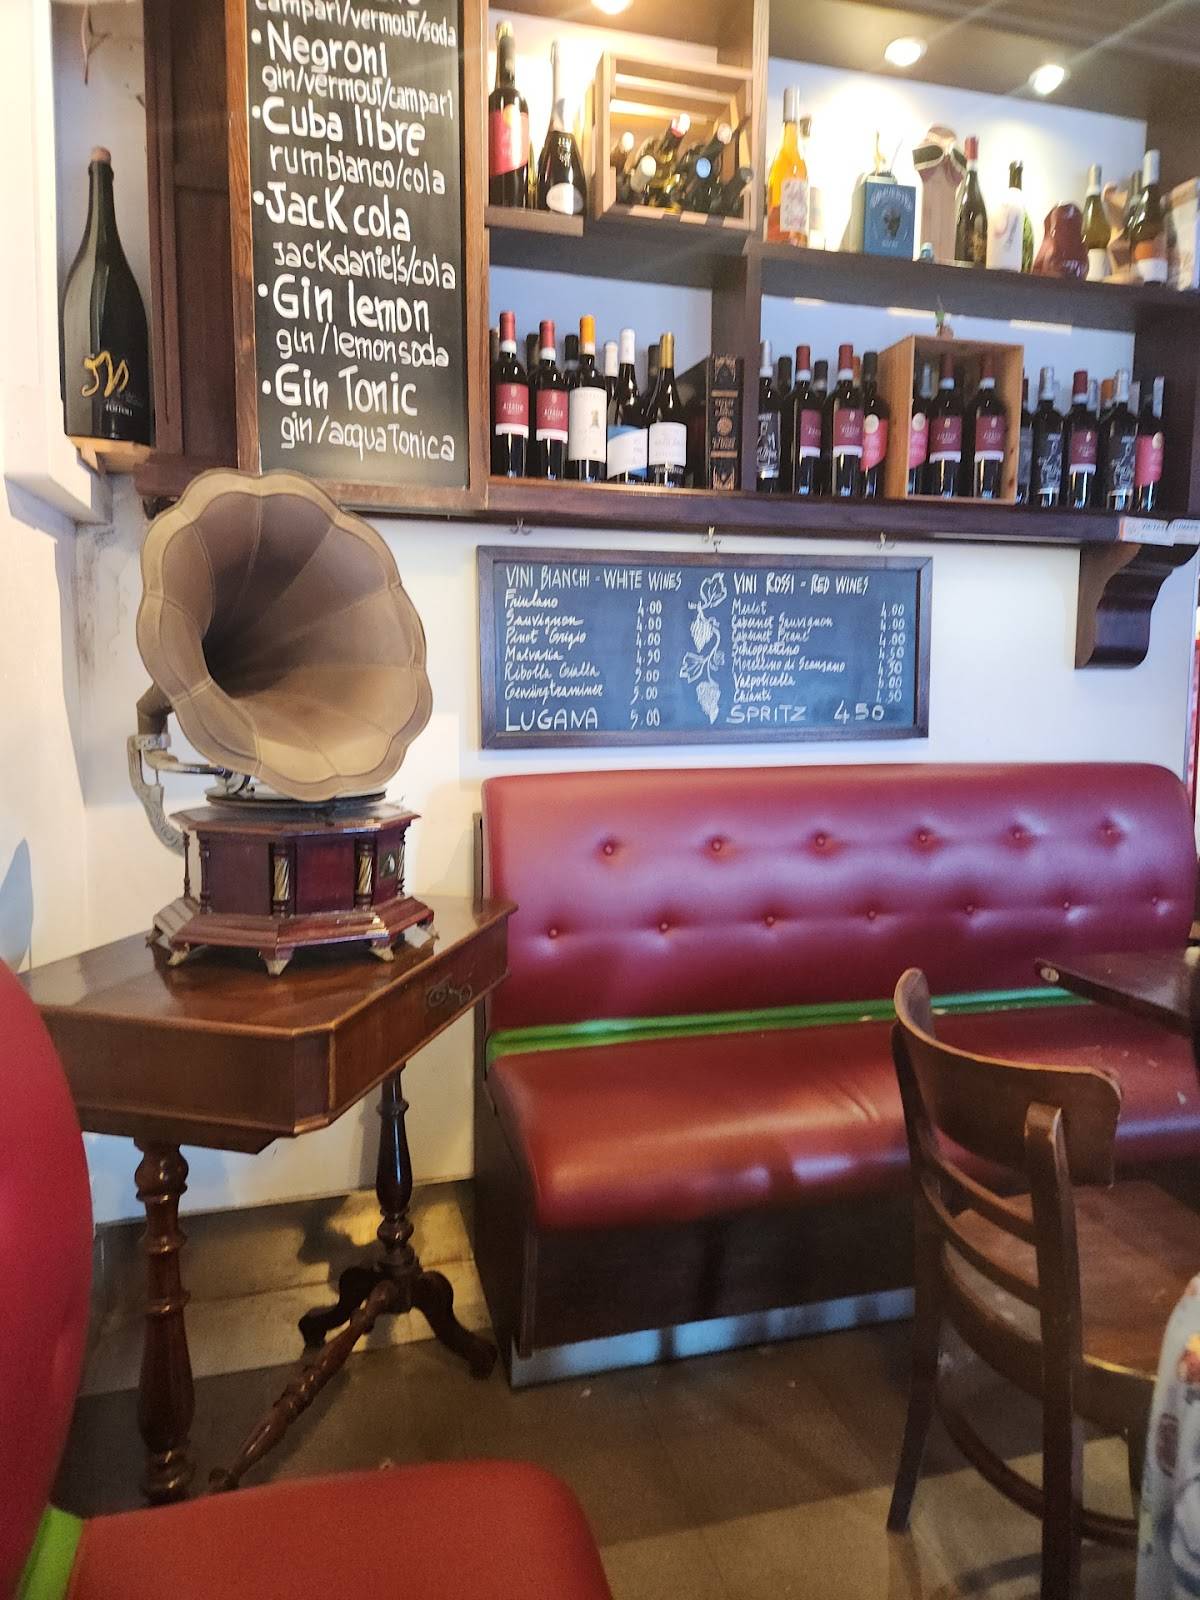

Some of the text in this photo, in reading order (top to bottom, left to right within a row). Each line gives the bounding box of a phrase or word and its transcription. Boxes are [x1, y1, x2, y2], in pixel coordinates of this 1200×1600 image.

[267, 20, 388, 78] Negroni
[262, 96, 426, 156] Cuba libre
[353, 194, 411, 242] cola
[273, 273, 430, 333] Gin lemon
[275, 363, 418, 417] Gin Tonic
[506, 565, 533, 589] VINI
[540, 564, 591, 591] BIANCHI
[603, 568, 644, 591] WHITE
[649, 570, 682, 592] WINES
[733, 572, 757, 595] VINI
[766, 571, 795, 596] ROSSI
[810, 574, 830, 596] RED
[835, 575, 869, 596] WINES
[504, 588, 559, 609] Friulano
[731, 597, 768, 615] Merlot
[505, 608, 584, 635] Sauvignon
[505, 627, 539, 645] Pinot
[549, 628, 587, 650] Grigio
[504, 661, 552, 681] Ribolla
[505, 705, 599, 732] LUGANA
[726, 703, 808, 724] SPRITZ
